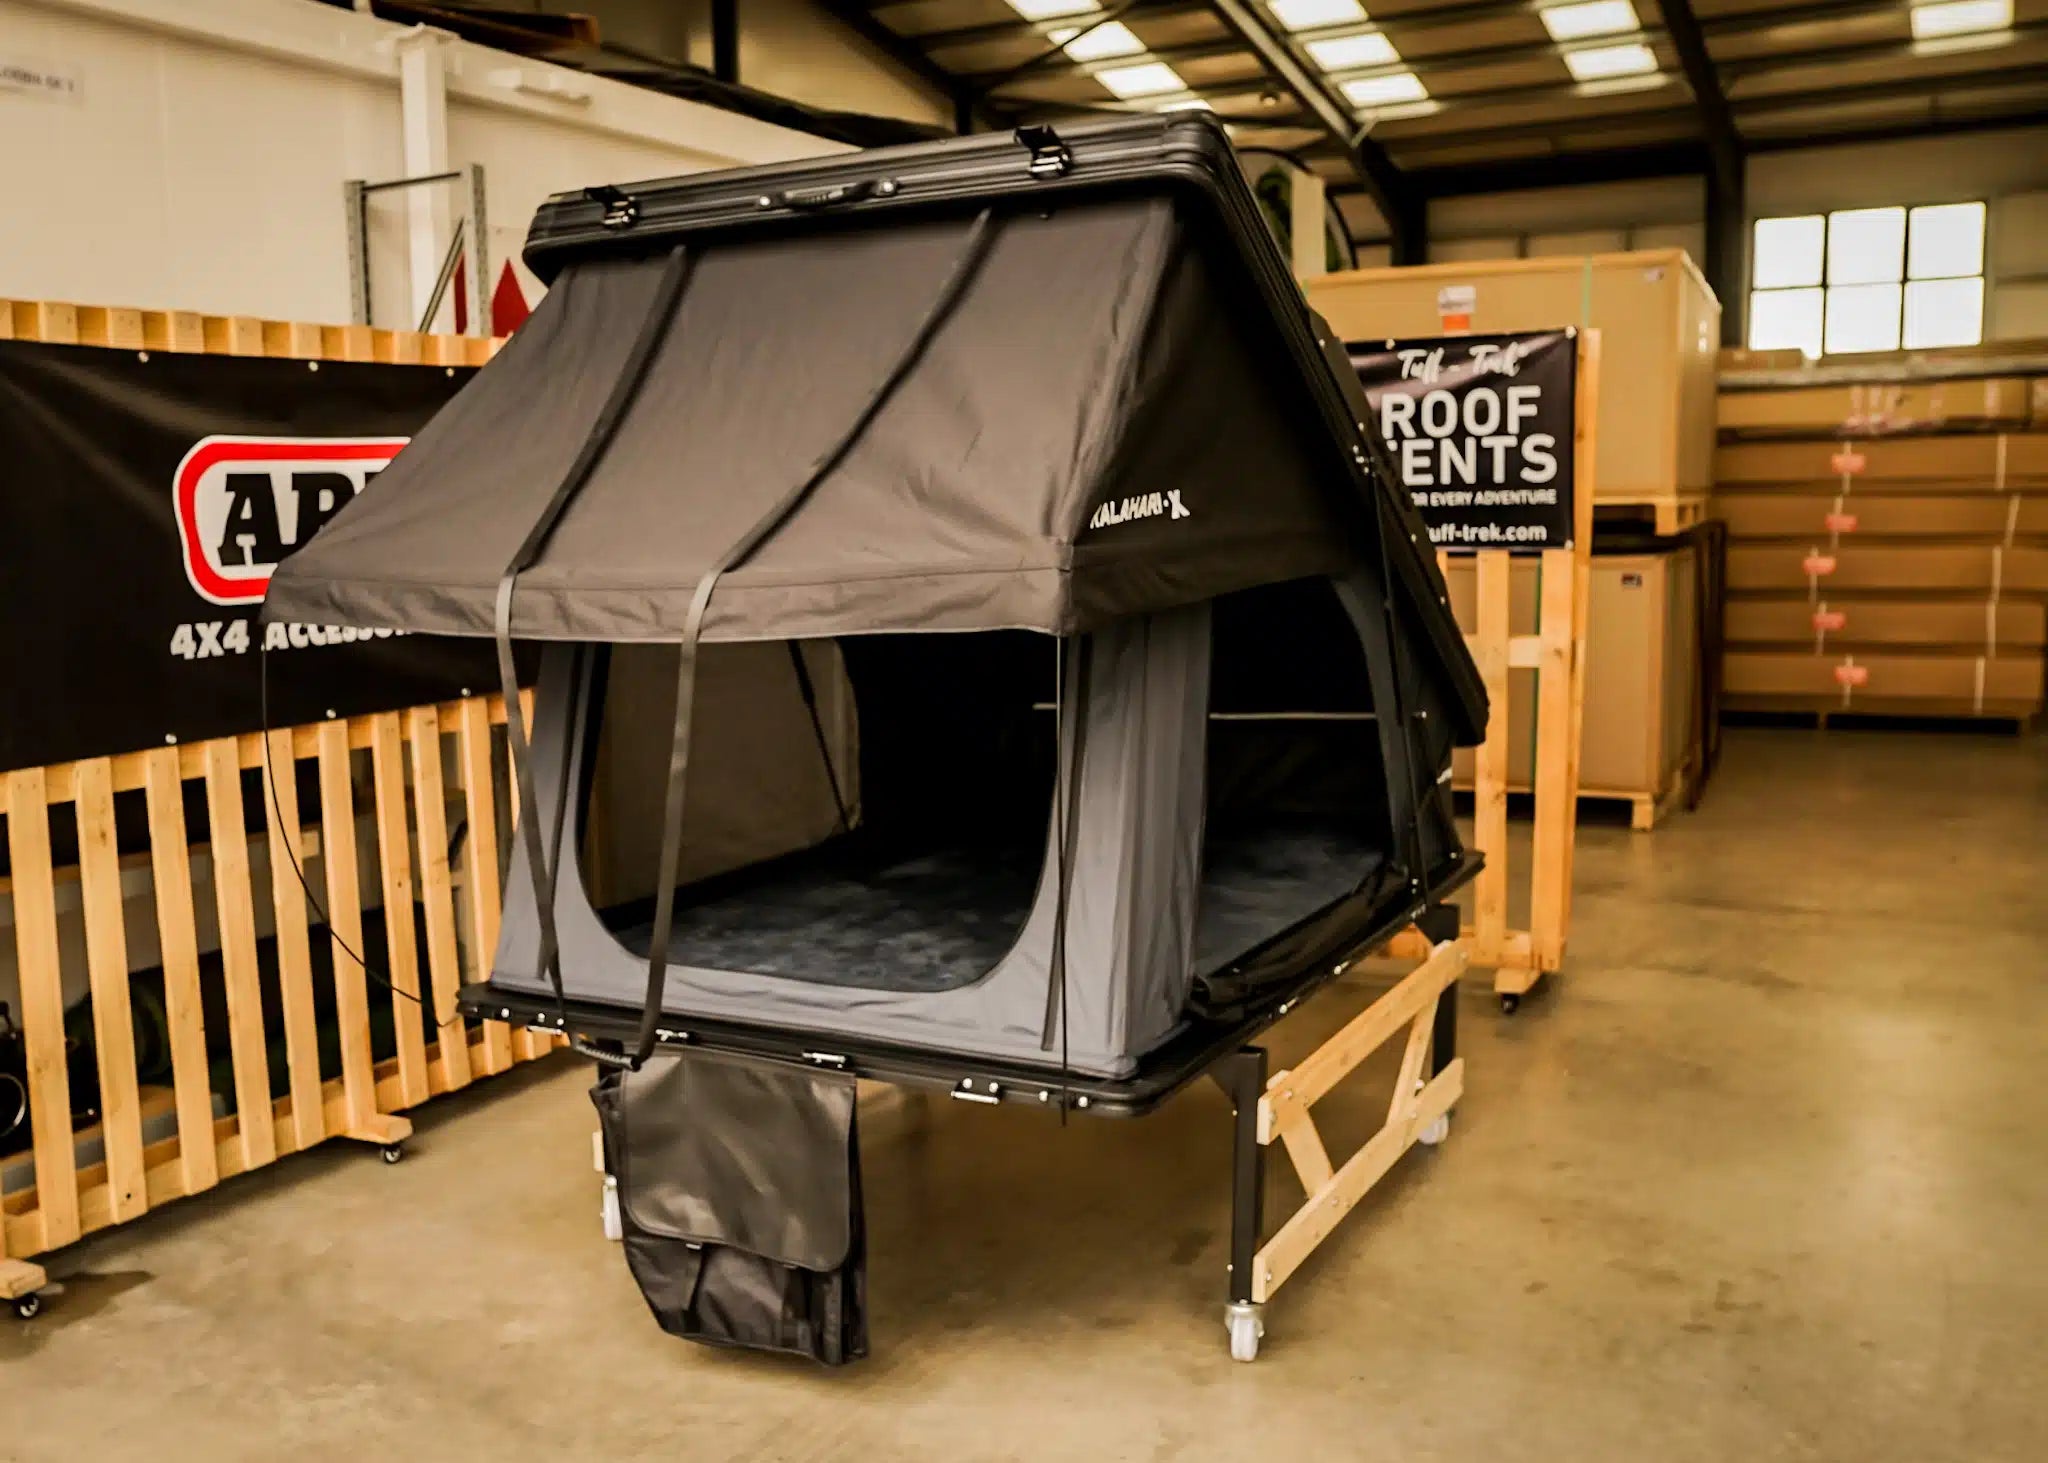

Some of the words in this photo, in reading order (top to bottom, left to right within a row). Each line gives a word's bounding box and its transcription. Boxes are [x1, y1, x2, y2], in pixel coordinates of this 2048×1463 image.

[1381, 385, 1542, 440] ROOF
[1386, 433, 1558, 487] ENTS
[217, 471, 382, 566] AR
[1430, 490, 1473, 507] EVERY
[1474, 488, 1557, 506] ADVENTURE
[1425, 522, 1548, 543] uff-trek.com
[170, 619, 250, 660] 4X4
